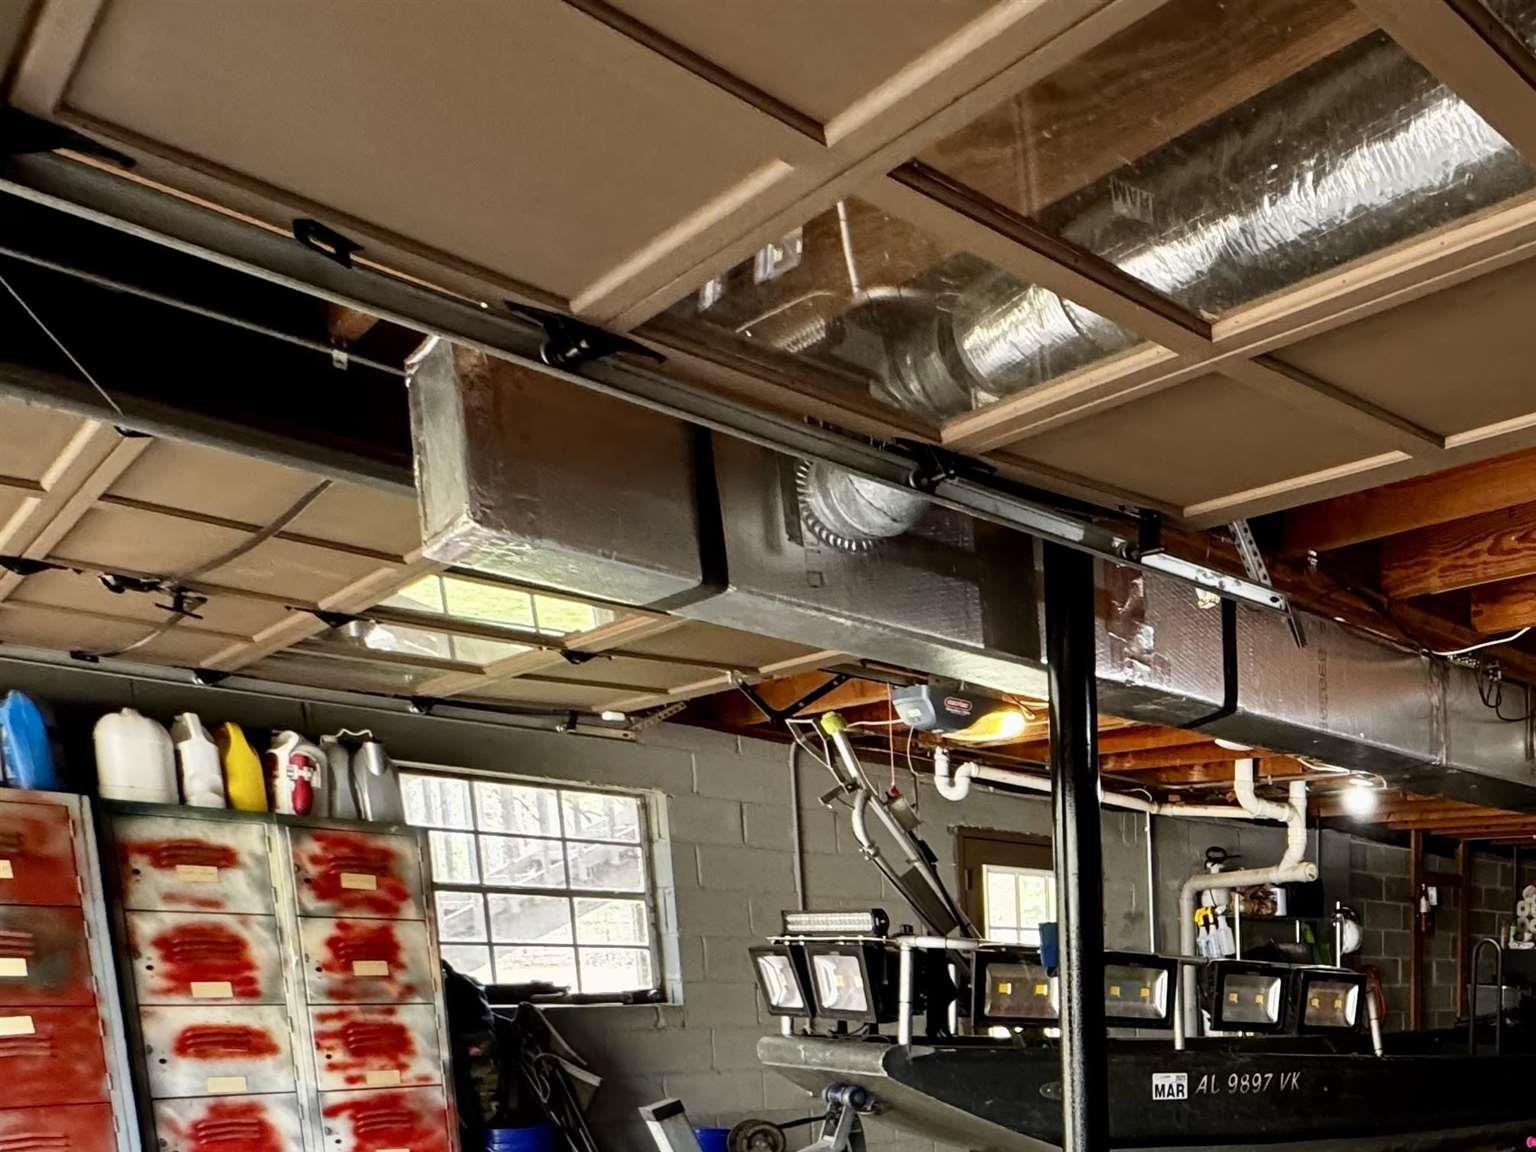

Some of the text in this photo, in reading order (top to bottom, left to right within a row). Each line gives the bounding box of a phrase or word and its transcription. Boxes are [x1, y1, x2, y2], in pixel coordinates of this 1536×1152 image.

[1154, 1083, 1185, 1098] MAR
[1195, 1071, 1301, 1095] AL 9897 VK
